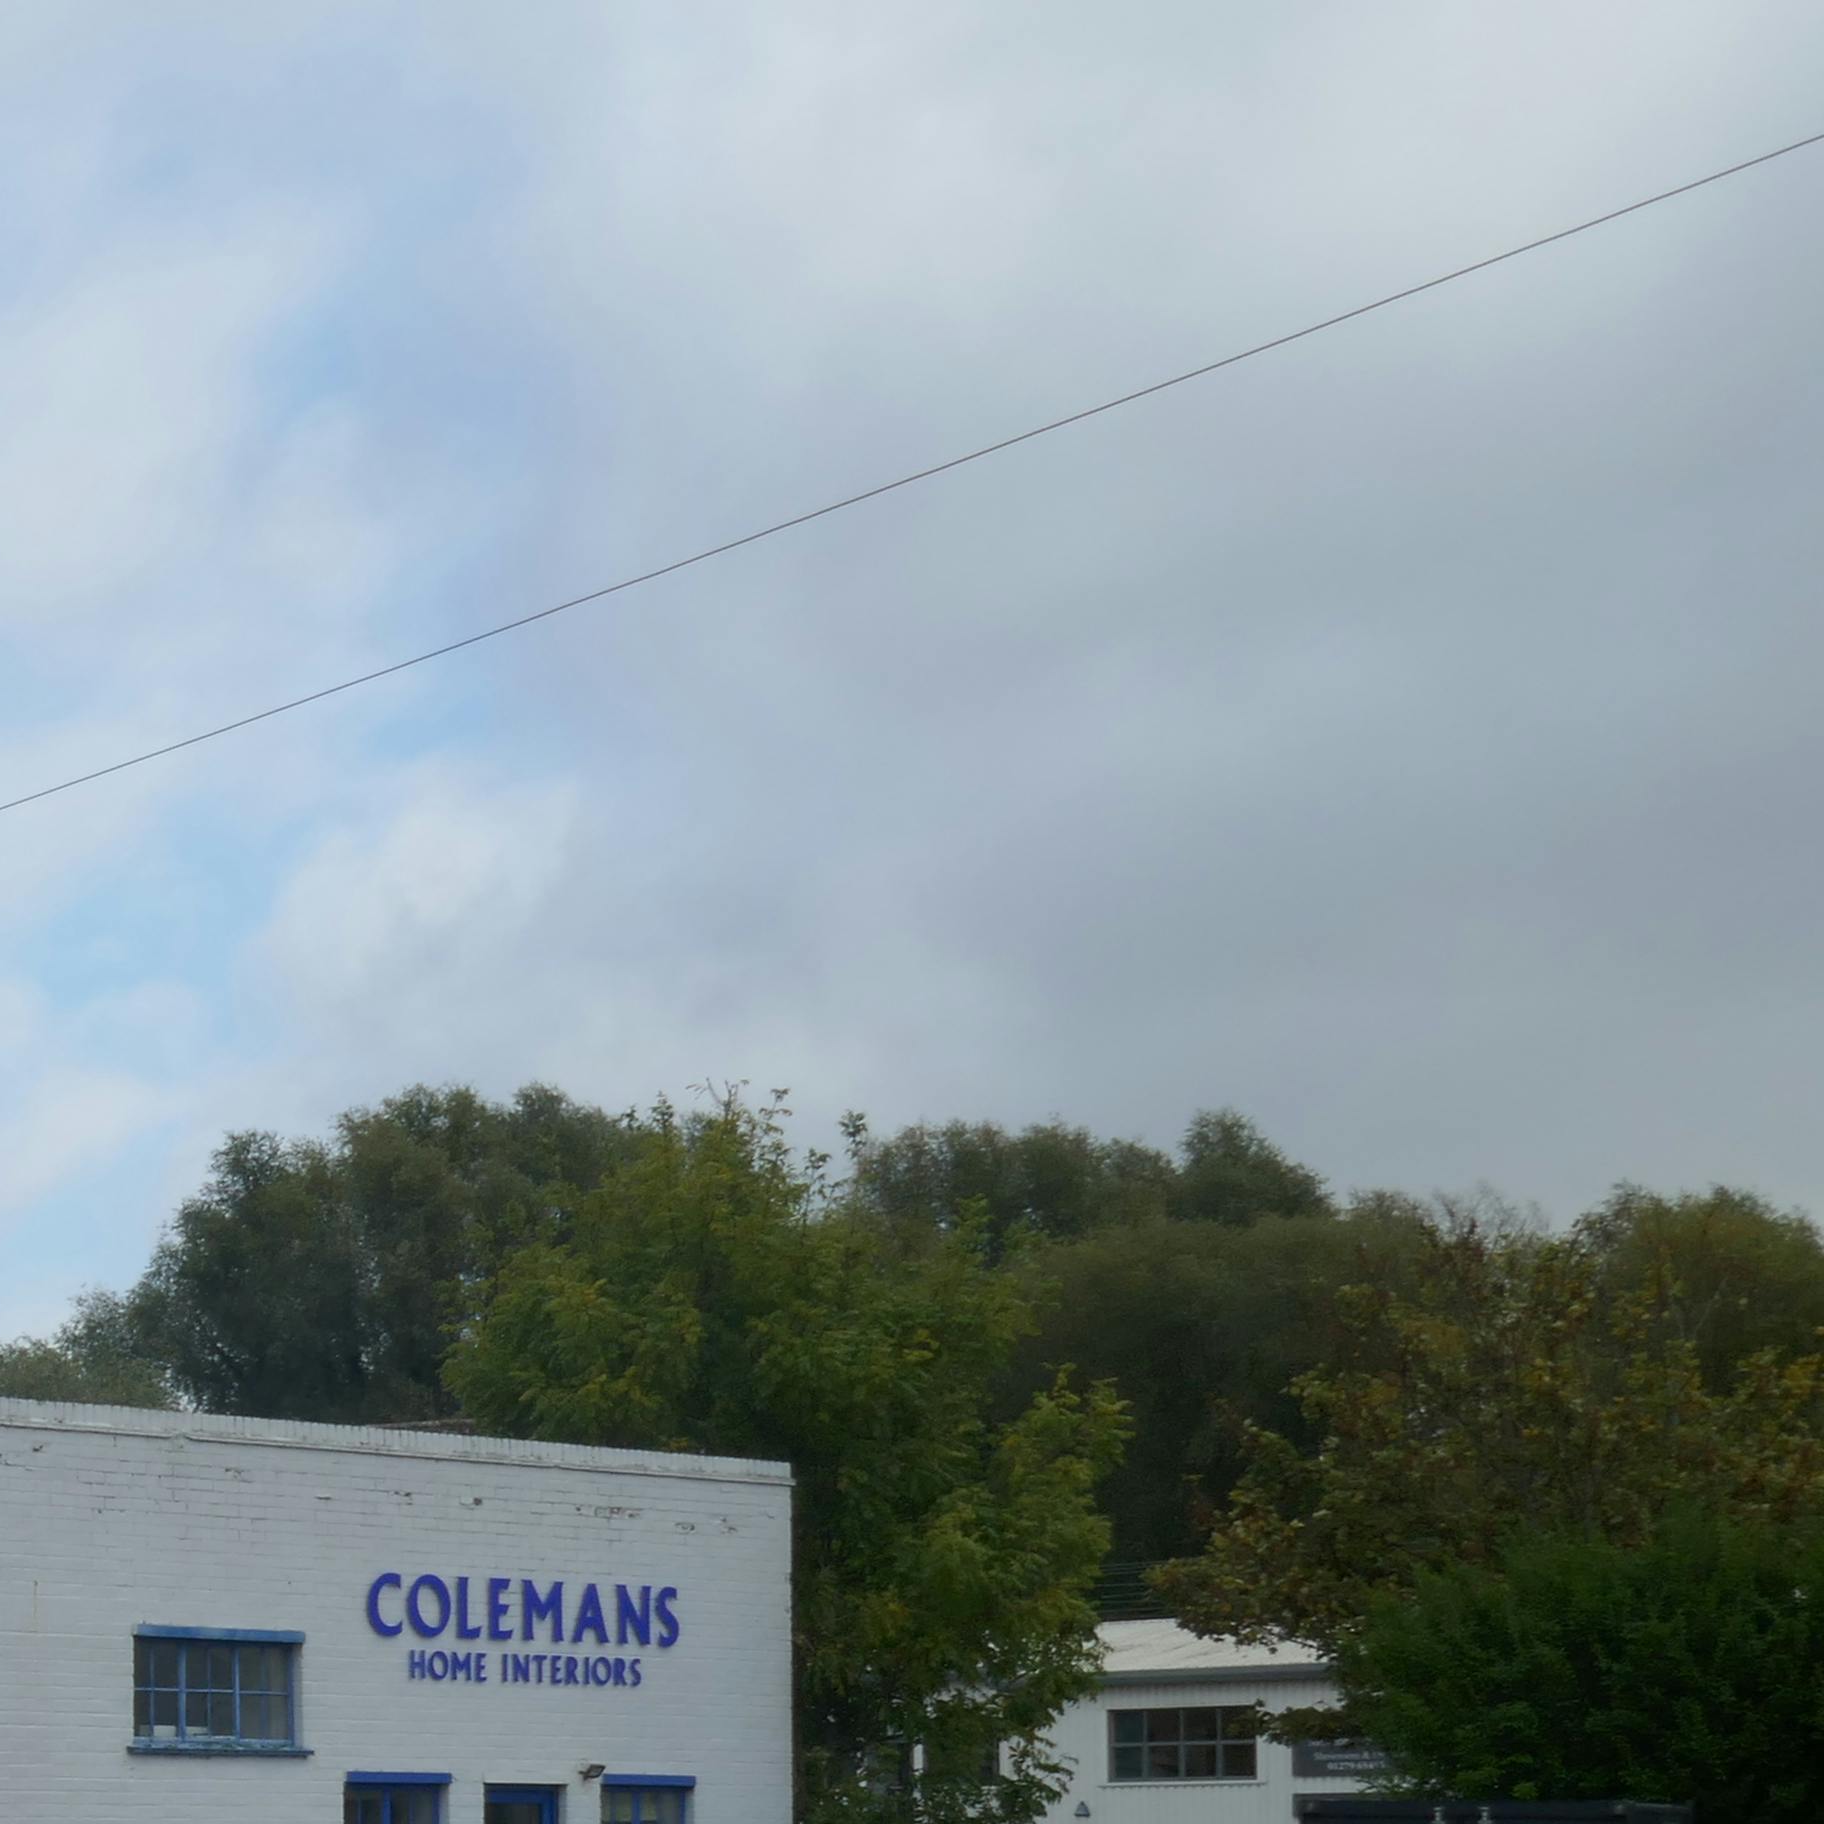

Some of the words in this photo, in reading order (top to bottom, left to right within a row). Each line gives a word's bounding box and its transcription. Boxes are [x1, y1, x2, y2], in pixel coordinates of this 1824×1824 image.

[366, 1572, 680, 1648] COLEMANS
[409, 1650, 487, 1682] HOME
[502, 1653, 642, 1687] INTERIORS
